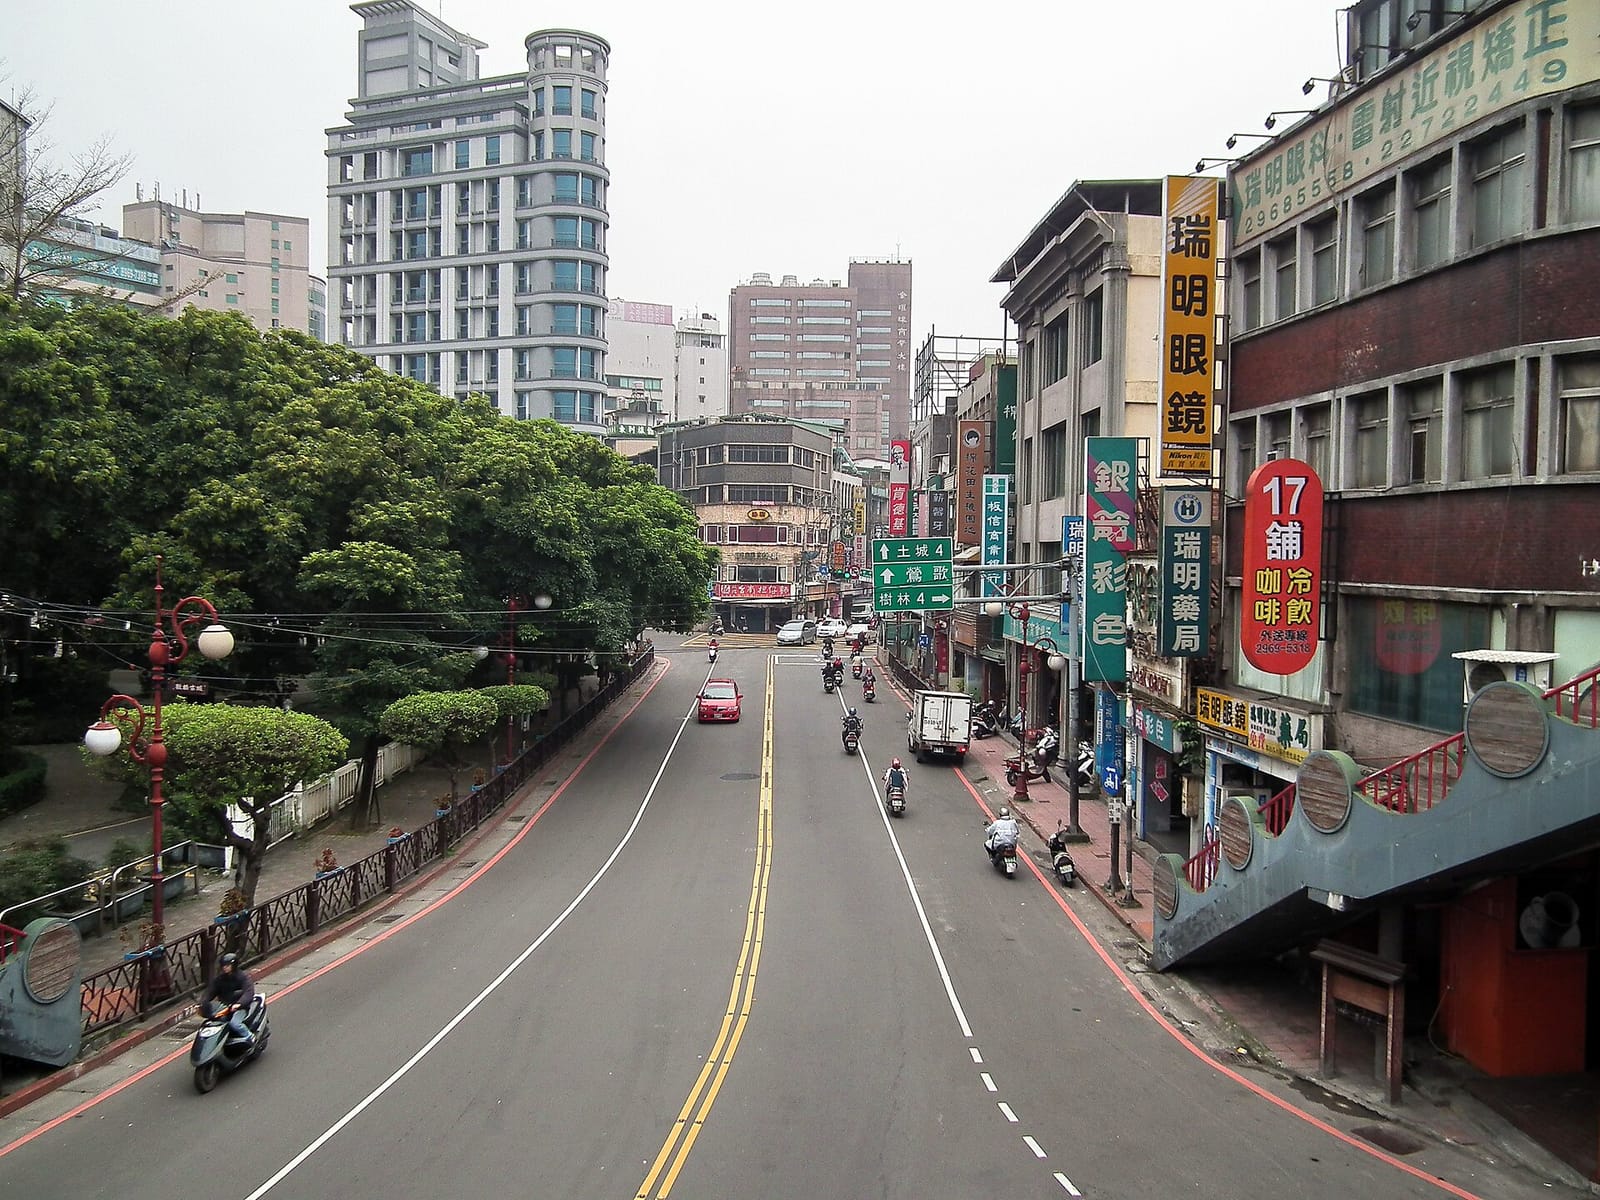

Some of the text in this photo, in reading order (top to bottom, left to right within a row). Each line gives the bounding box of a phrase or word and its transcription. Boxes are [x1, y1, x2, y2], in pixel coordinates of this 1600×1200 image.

[1168, 214, 1211, 434] 瑞明眼鏡
[892, 486, 905, 530] 肯德基
[1263, 476, 1308, 516] 17
[897, 544, 943, 557] 土城 4
[906, 565, 949, 583] 鶯歌
[880, 592, 925, 607] 樹林 4
[1172, 532, 1201, 653] 瑞明藥局
[1256, 643, 1311, 654] 2969-5318
[1260, 629, 1308, 641] 外送專線
[1199, 693, 1246, 731] 瑞明眼鏡
